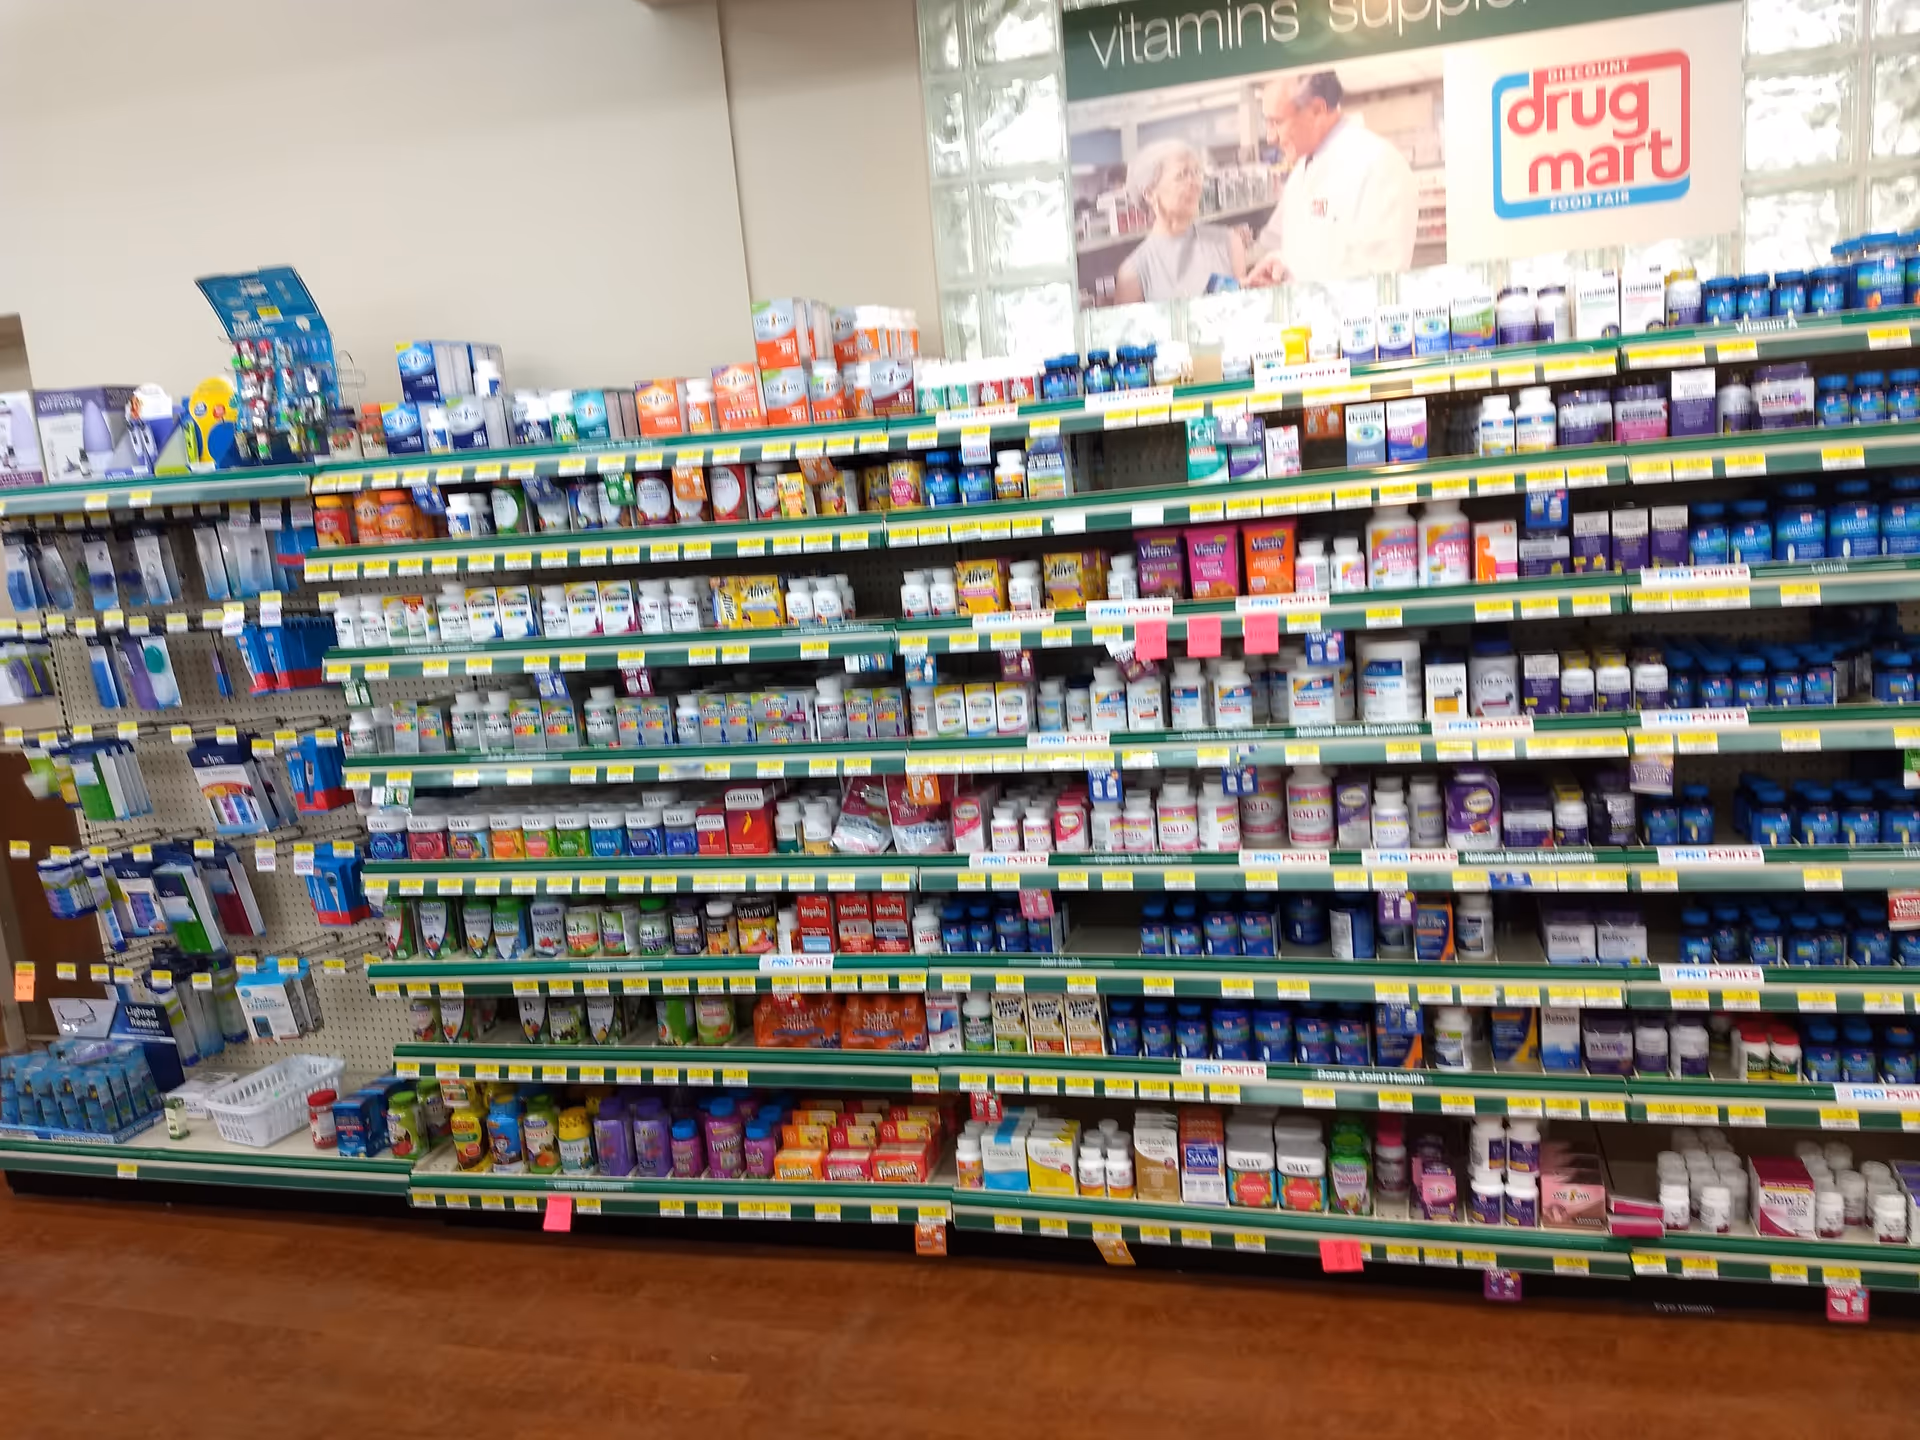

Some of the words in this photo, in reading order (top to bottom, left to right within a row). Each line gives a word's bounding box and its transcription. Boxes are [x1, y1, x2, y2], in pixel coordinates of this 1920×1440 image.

[1089, 1, 1299, 70] vitamins
[1547, 59, 1630, 83] DISCOUNT
[1507, 71, 1650, 140] drug
[1529, 130, 1685, 195] mart
[1550, 194, 1592, 212] FOOD
[1596, 190, 1630, 206] FAIR
[1296, 725, 1333, 738] National
[1334, 724, 1363, 737] Brand
[1364, 723, 1419, 738] Equivalents
[1465, 852, 1504, 864] National
[1506, 851, 1536, 863] Brand
[1538, 852, 1595, 864] Equivalents
[800, 905, 827, 918] MegaRed
[839, 903, 868, 916] MegaRed
[876, 903, 903, 916] MegaRed
[125, 1005, 157, 1019] Lighted
[130, 1016, 160, 1029] Reader
[1317, 1069, 1346, 1082] Bone
[1348, 1071, 1357, 1082] &
[1358, 1071, 1387, 1084] Joint
[1388, 1072, 1425, 1085] Health
